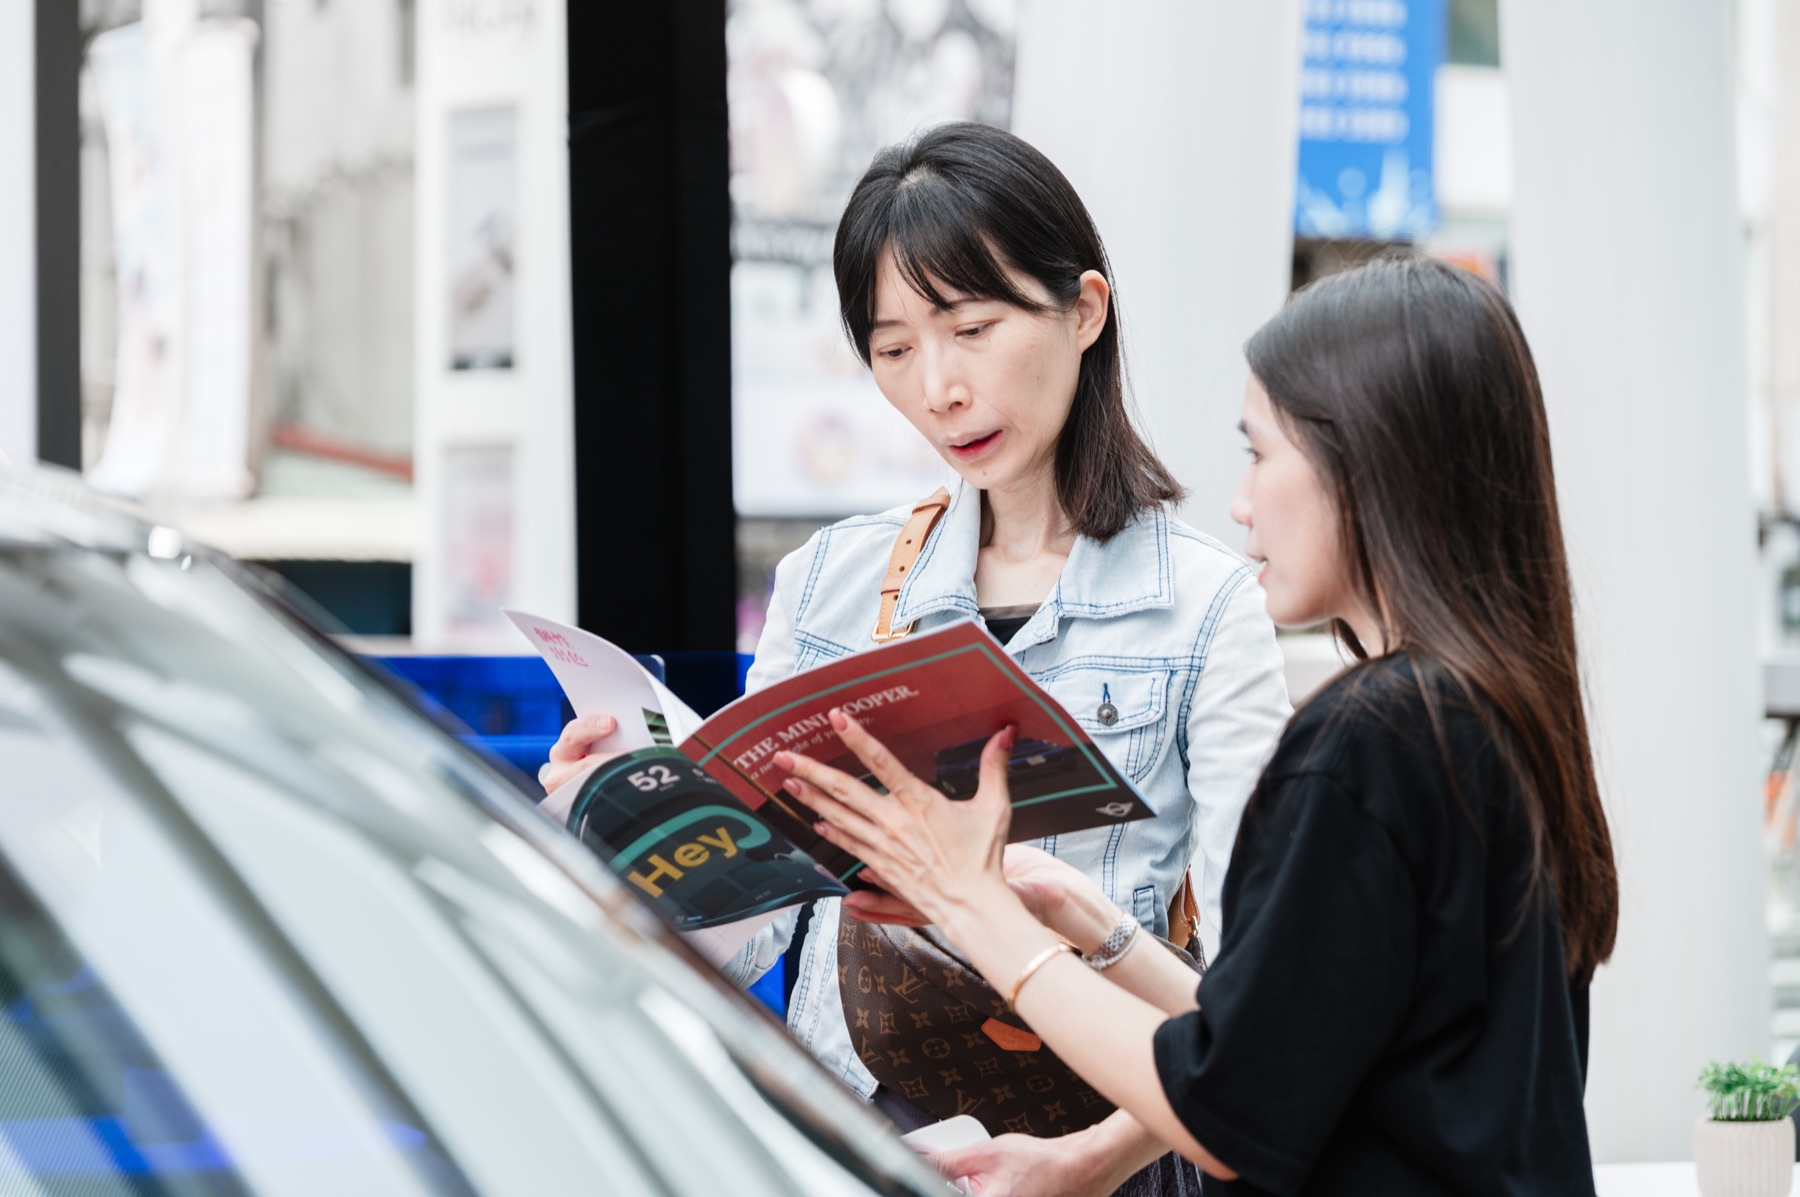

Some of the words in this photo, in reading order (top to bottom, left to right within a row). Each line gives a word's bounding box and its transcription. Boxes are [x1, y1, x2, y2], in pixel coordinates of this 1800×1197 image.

[733, 736, 780, 771] THE
[776, 712, 830, 744] MINI
[842, 685, 919, 715] OOPER.
[627, 765, 680, 791] 52
[627, 827, 738, 898] Hey
